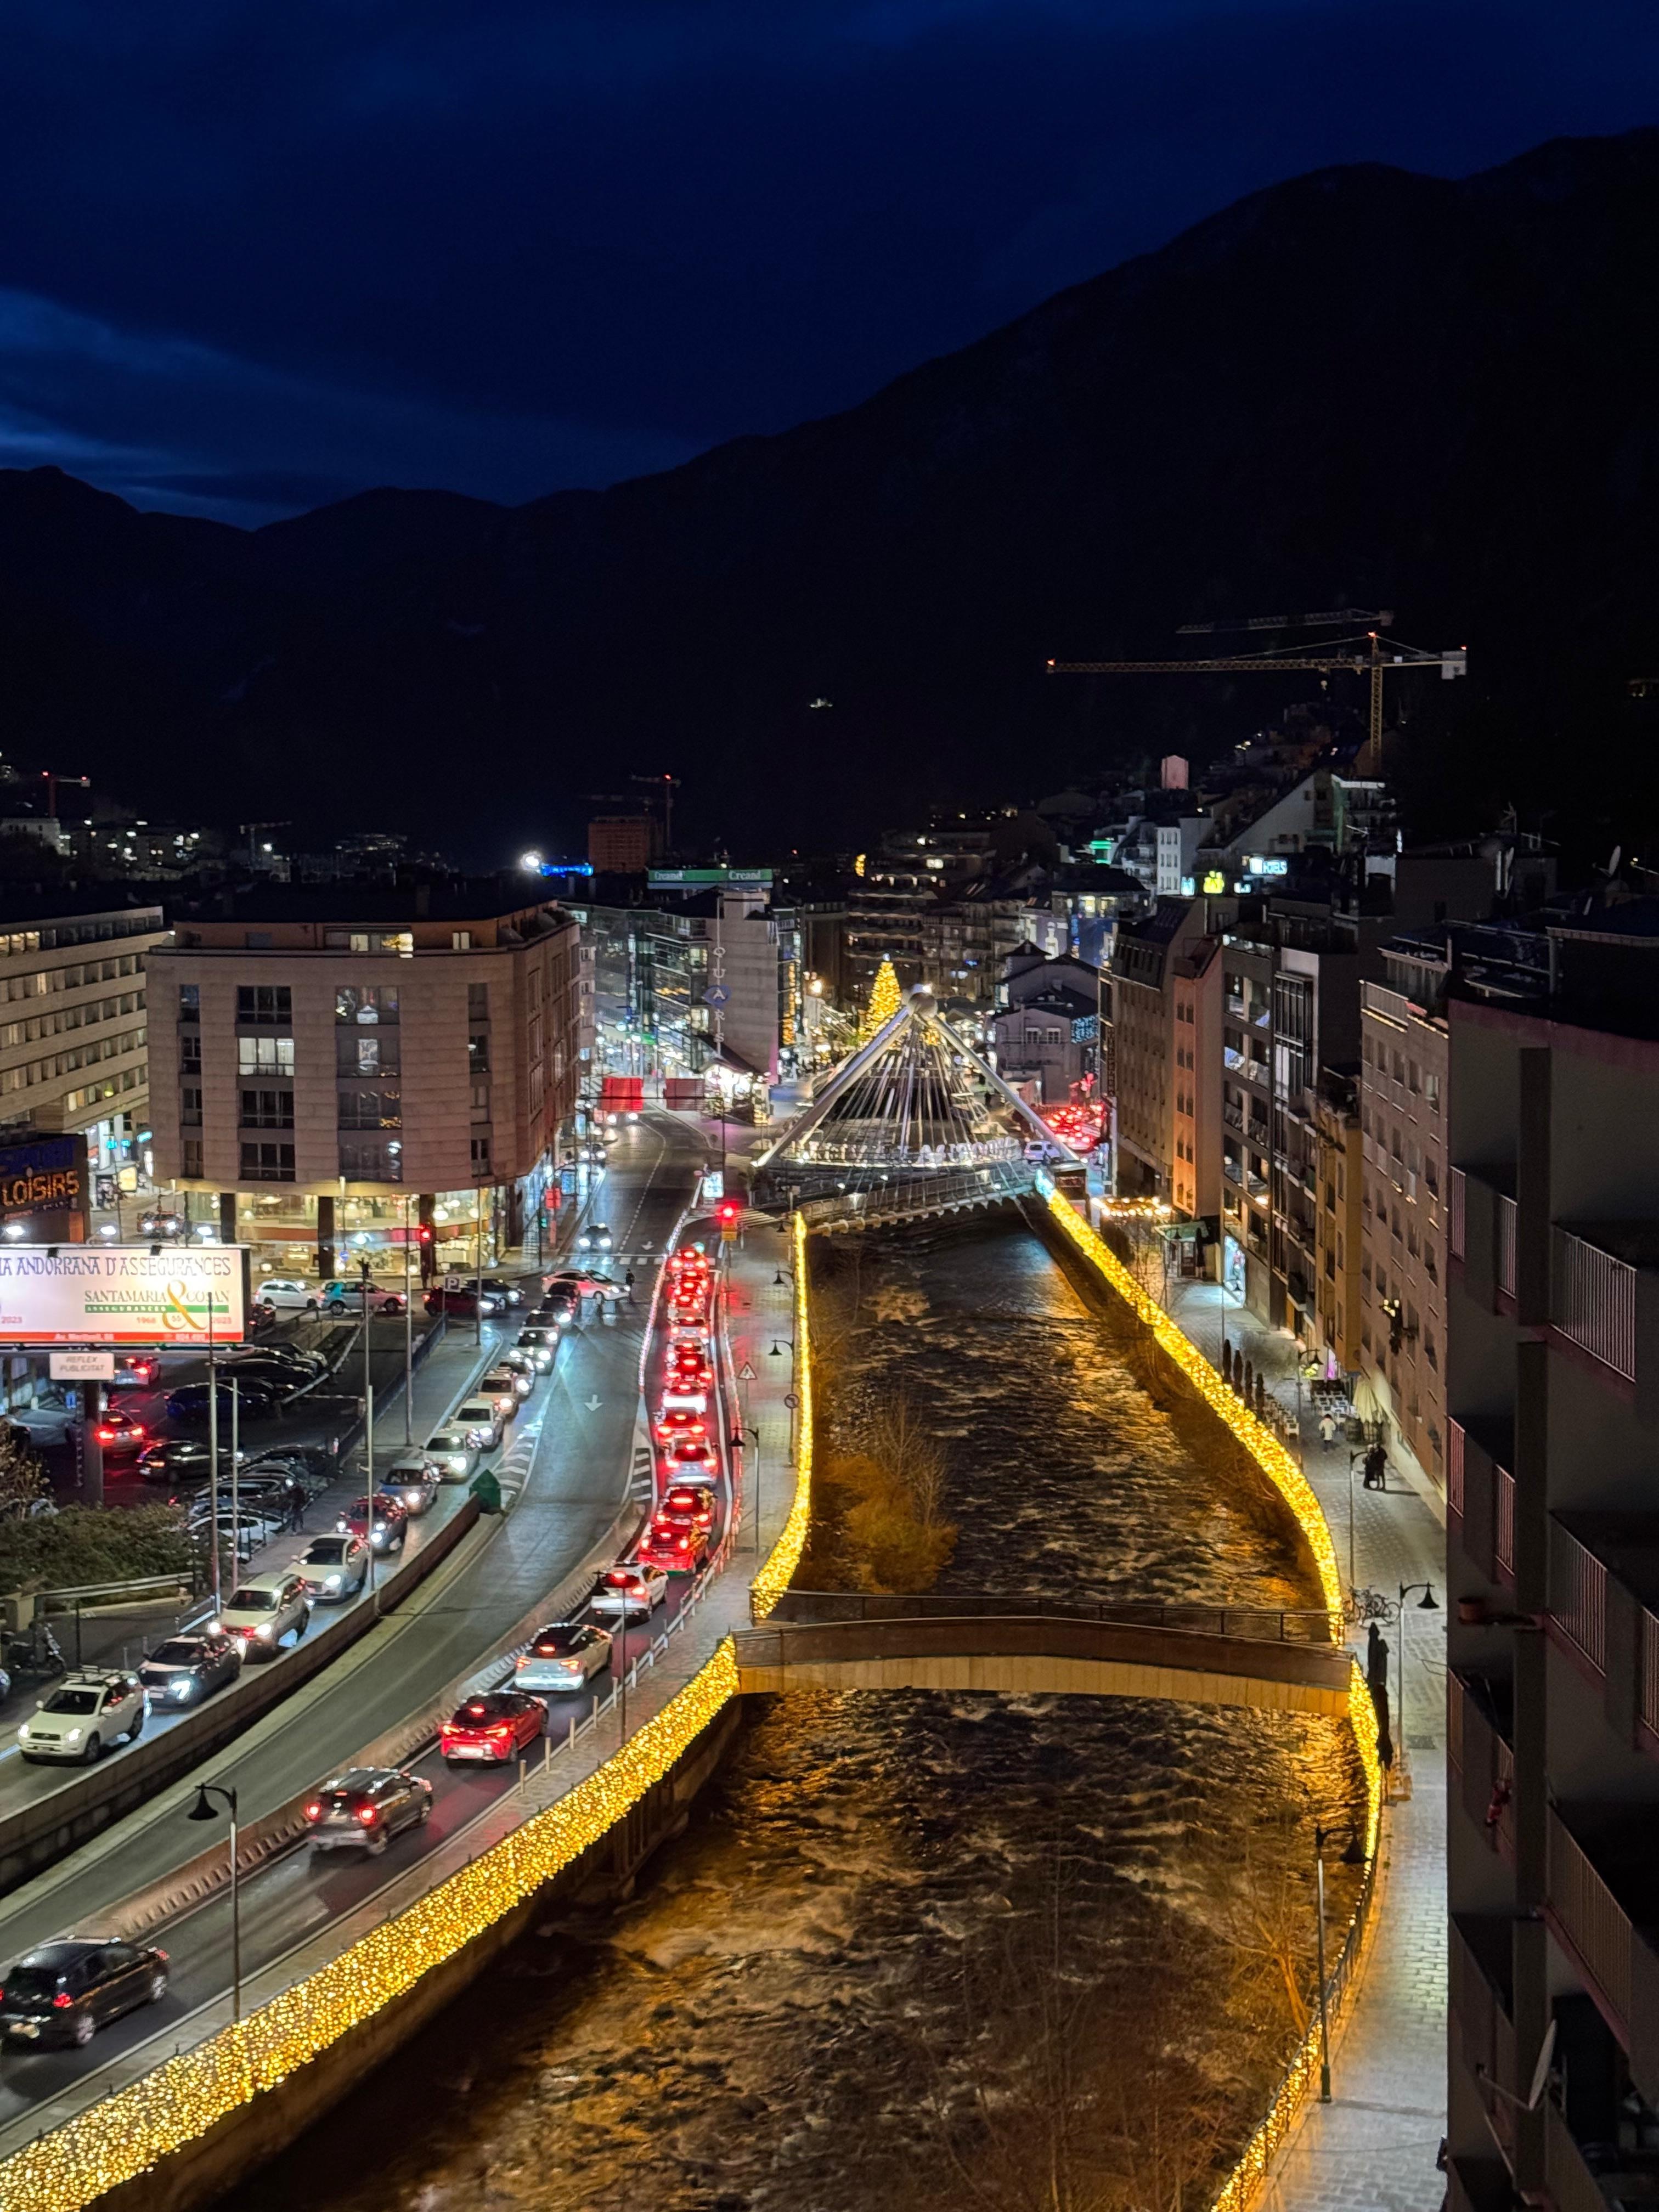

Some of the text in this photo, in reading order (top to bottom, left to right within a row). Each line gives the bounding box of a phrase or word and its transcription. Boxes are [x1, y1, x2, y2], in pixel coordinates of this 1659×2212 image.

[654, 871, 683, 880] Creand
[729, 870, 761, 880] Creand
[16, 1256, 101, 1276] ANDORRANA
[447, 1278, 458, 1289] P
[84, 1290, 166, 1302] SANTAMARIA
